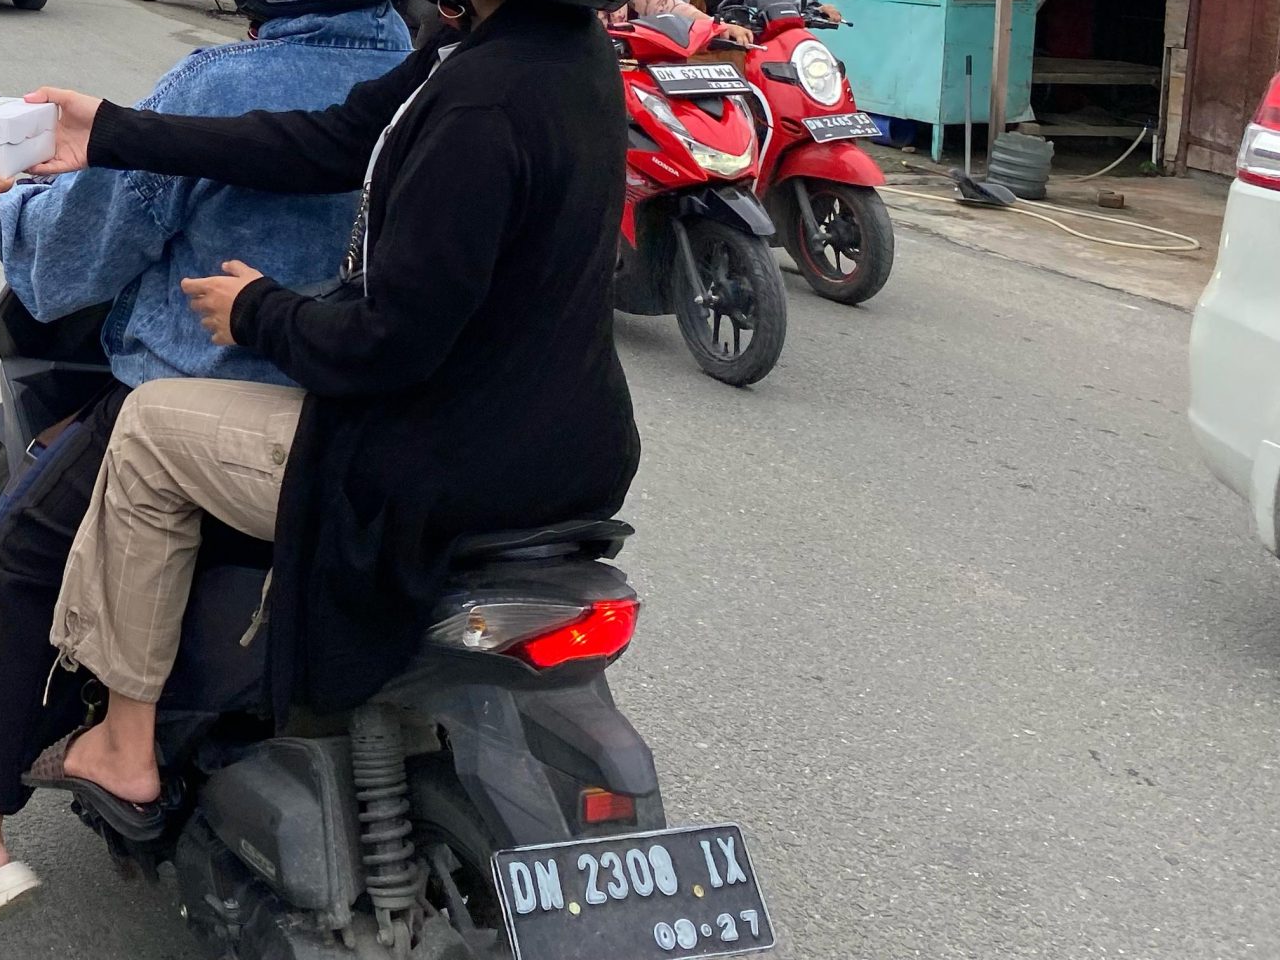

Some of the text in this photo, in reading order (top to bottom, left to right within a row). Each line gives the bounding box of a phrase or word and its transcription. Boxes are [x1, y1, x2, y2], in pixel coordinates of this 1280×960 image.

[656, 70, 675, 79] DN
[680, 68, 712, 79] 6377
[806, 119, 824, 130] DN
[652, 156, 680, 177] HONDA
[508, 836, 747, 914] DN 2308 IX
